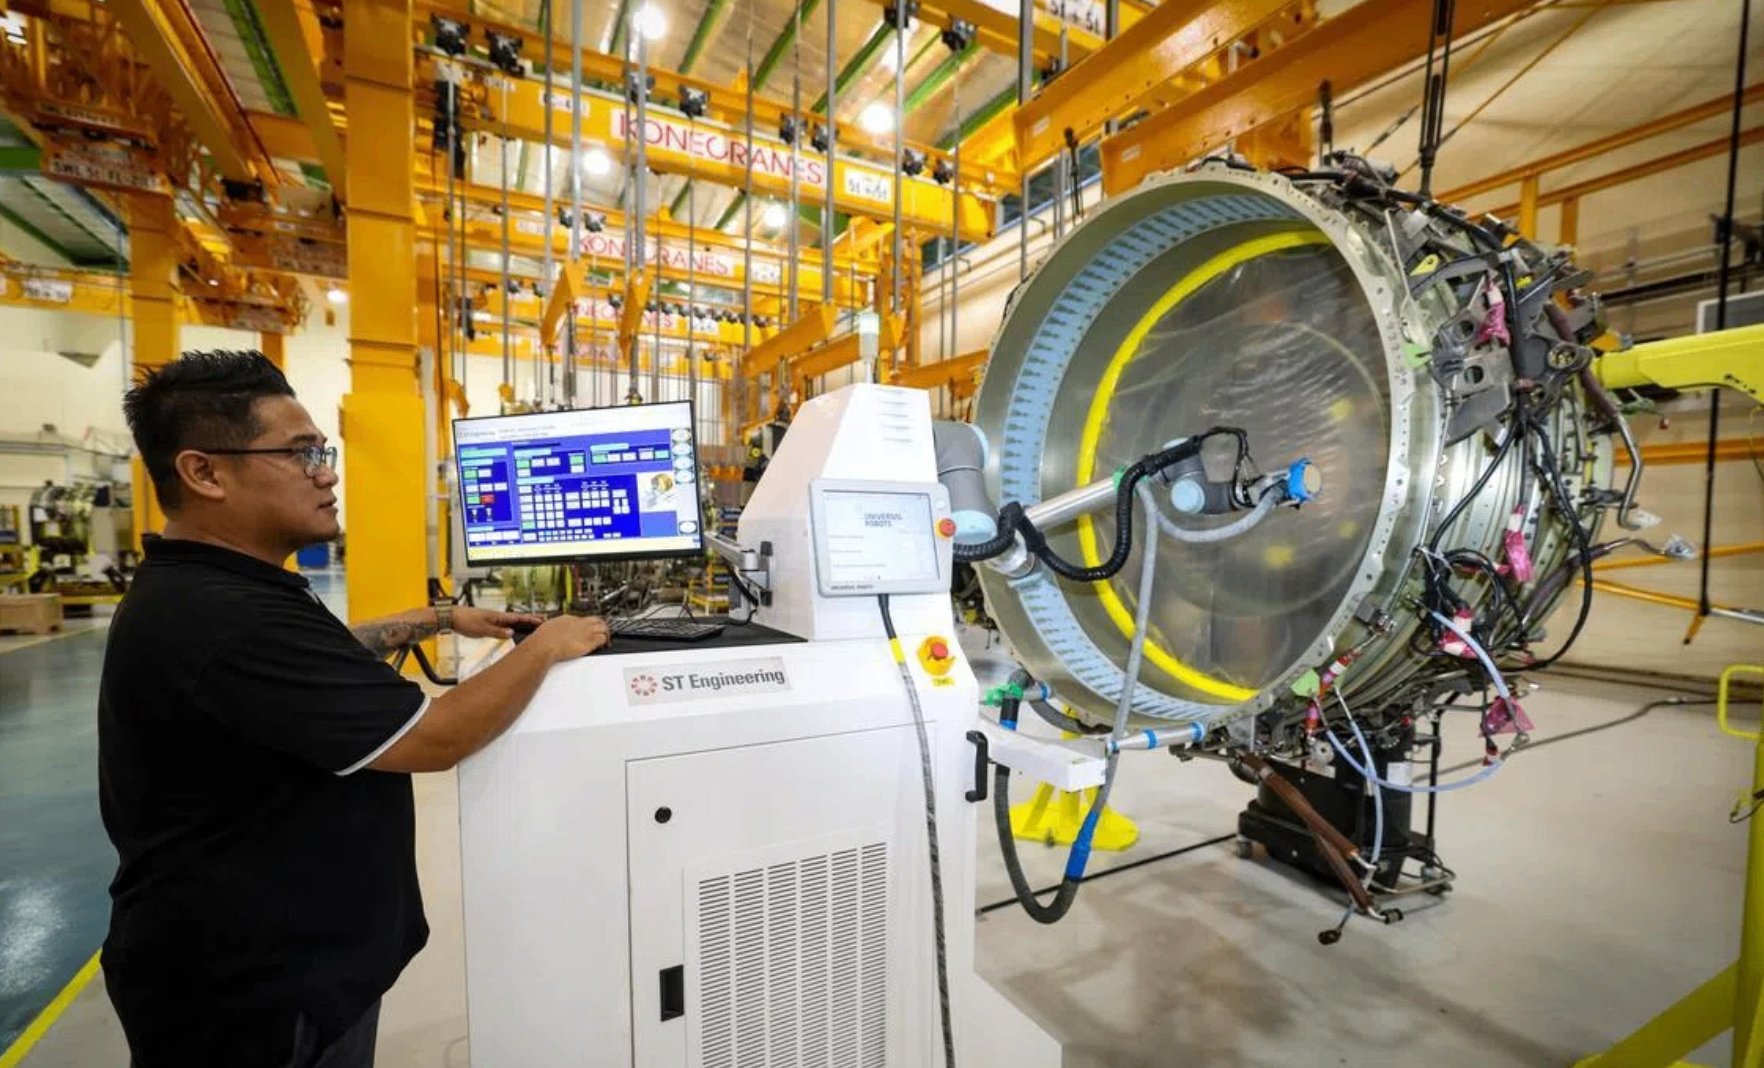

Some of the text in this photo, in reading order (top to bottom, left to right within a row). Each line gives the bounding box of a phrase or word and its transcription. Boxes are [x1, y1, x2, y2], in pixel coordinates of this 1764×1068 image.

[619, 113, 822, 185] KONECRANES
[578, 233, 730, 276] KONRANES
[864, 512, 903, 520] UNIVERSAL
[864, 520, 892, 528] ROBOTS
[662, 668, 786, 691] ST Engineering
